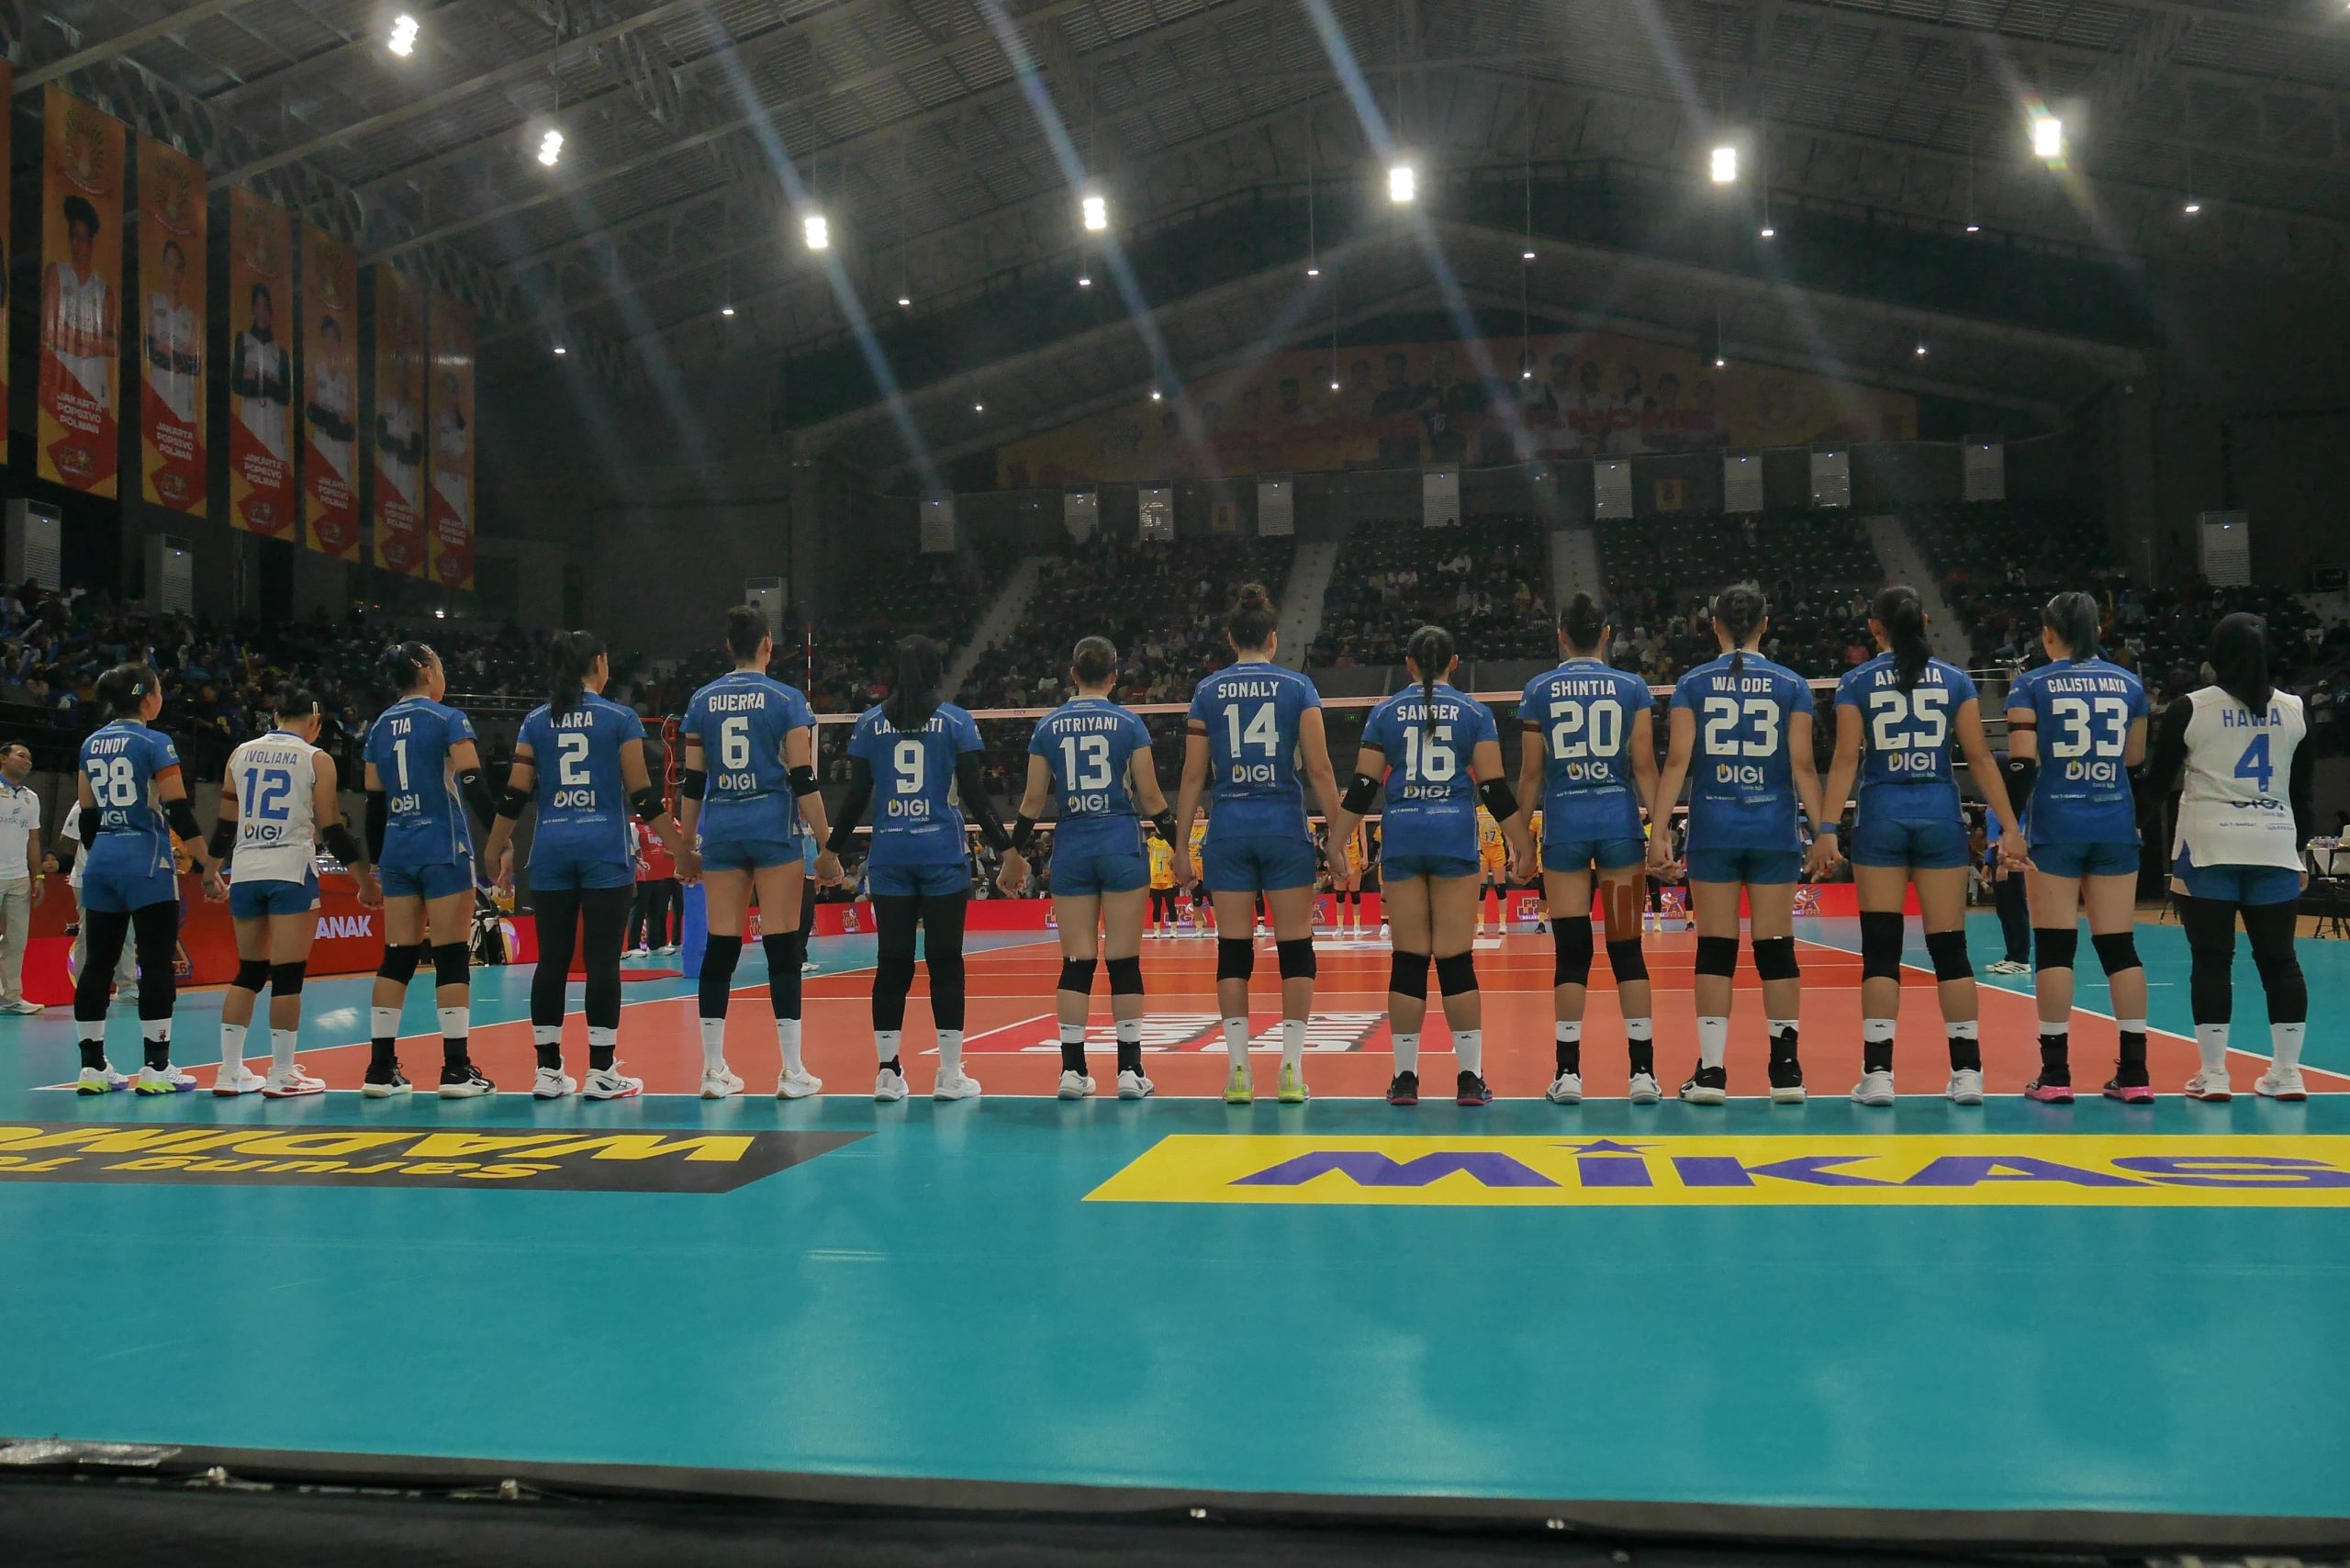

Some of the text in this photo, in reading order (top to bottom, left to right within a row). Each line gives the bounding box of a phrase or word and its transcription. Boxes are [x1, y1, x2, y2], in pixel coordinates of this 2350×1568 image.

[1217, 681, 1280, 700] SONALY
[1550, 679, 1617, 698] SHINTIA
[1711, 677, 1773, 693] WA ODE
[2047, 678, 2129, 693] CALISTA MAYA
[709, 692, 765, 712] GUERRA
[390, 717, 411, 736] TIA
[1052, 717, 1118, 735] FITRIYANI
[1704, 697, 1780, 757] 23
[1870, 689, 1950, 750] 25
[2052, 698, 2129, 757] 33
[2222, 708, 2282, 727] HAWA
[1222, 702, 1280, 758] 14
[1550, 700, 1622, 759] 20
[90, 737, 130, 755] CINDY
[722, 716, 750, 769] 6
[1403, 725, 1456, 781] 16
[244, 750, 298, 765] IVOLIANA
[392, 739, 408, 790] 1
[557, 733, 590, 785] 2
[894, 740, 924, 793] 9
[1058, 734, 1113, 791] 13
[1887, 752, 1936, 772] DIGI
[2233, 733, 2274, 793] 4
[718, 772, 757, 790] DIGI
[1232, 764, 1275, 783] DIGI
[1716, 763, 1764, 784] DIGI
[2065, 760, 2117, 781] DIGI
[86, 756, 139, 808] 28
[243, 767, 292, 820] 12
[554, 790, 596, 808] DIGI
[1068, 793, 1110, 813] DIGI
[888, 799, 930, 817] DIGI
[244, 822, 283, 840] DIGI
[315, 914, 374, 940] ANAK
[103, 1156, 562, 1179] Sarung
